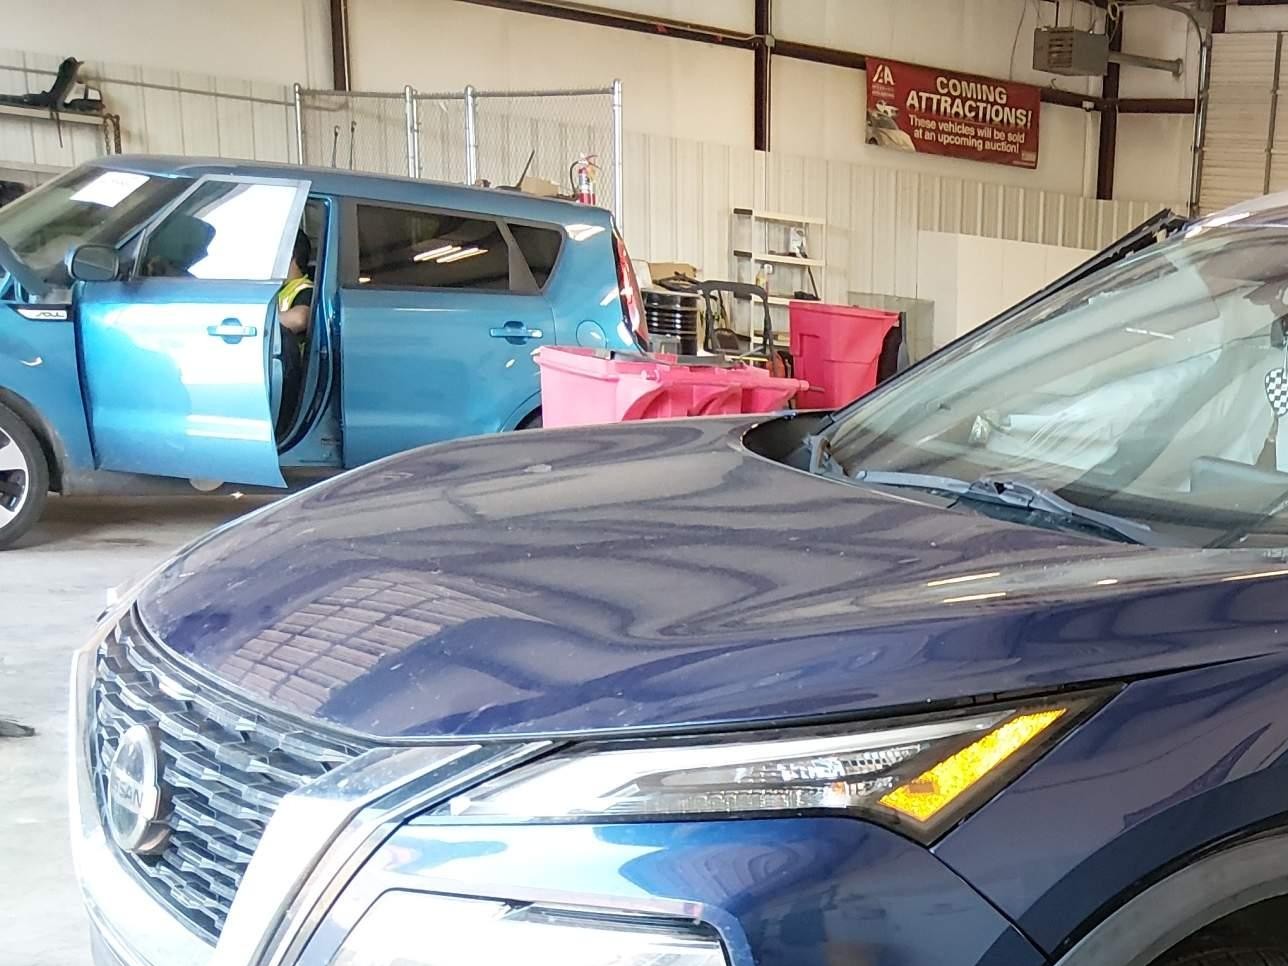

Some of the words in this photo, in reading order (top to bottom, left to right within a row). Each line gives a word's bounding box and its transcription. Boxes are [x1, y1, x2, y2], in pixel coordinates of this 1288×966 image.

[936, 76, 1007, 104] COMING
[906, 90, 1032, 128] ATTRACTIONS!
[908, 114, 936, 130] These
[938, 121, 975, 136] vehicles
[977, 127, 992, 138] will
[994, 129, 1005, 141] be
[1007, 132, 1025, 143] sold
[914, 128, 923, 139] at
[924, 130, 936, 141] an
[938, 133, 983, 151] upcoming
[984, 139, 1020, 154] auction!
